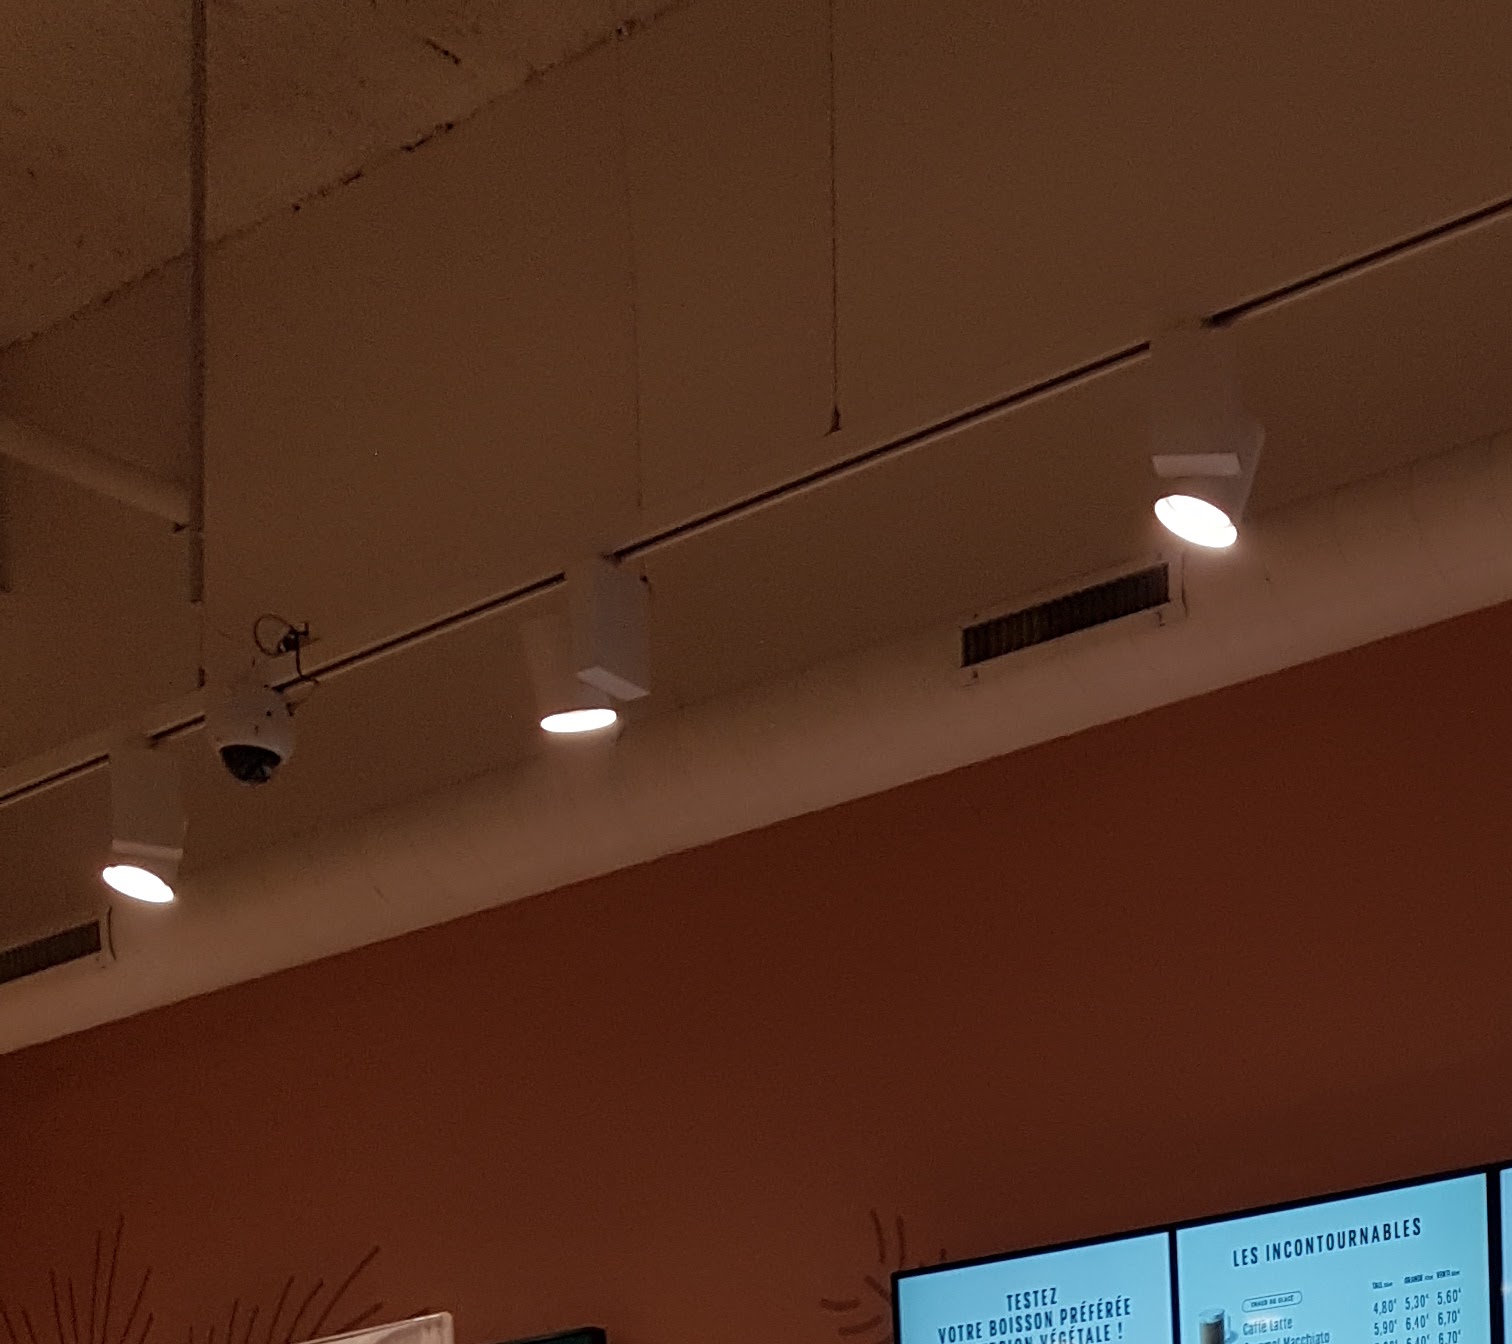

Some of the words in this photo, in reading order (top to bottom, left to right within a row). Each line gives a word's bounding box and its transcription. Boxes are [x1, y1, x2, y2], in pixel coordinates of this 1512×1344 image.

[1233, 1247, 1258, 1267] LES
[1266, 1217, 1421, 1263] INCONTOURNABLES
[1006, 1287, 1057, 1312] TESTEZ
[938, 1322, 982, 1344] VOTRE
[989, 1311, 1053, 1337] BOISSON
[1060, 1295, 1131, 1326] PRÉFÉRÉE
[1118, 1322, 1123, 1339] !
